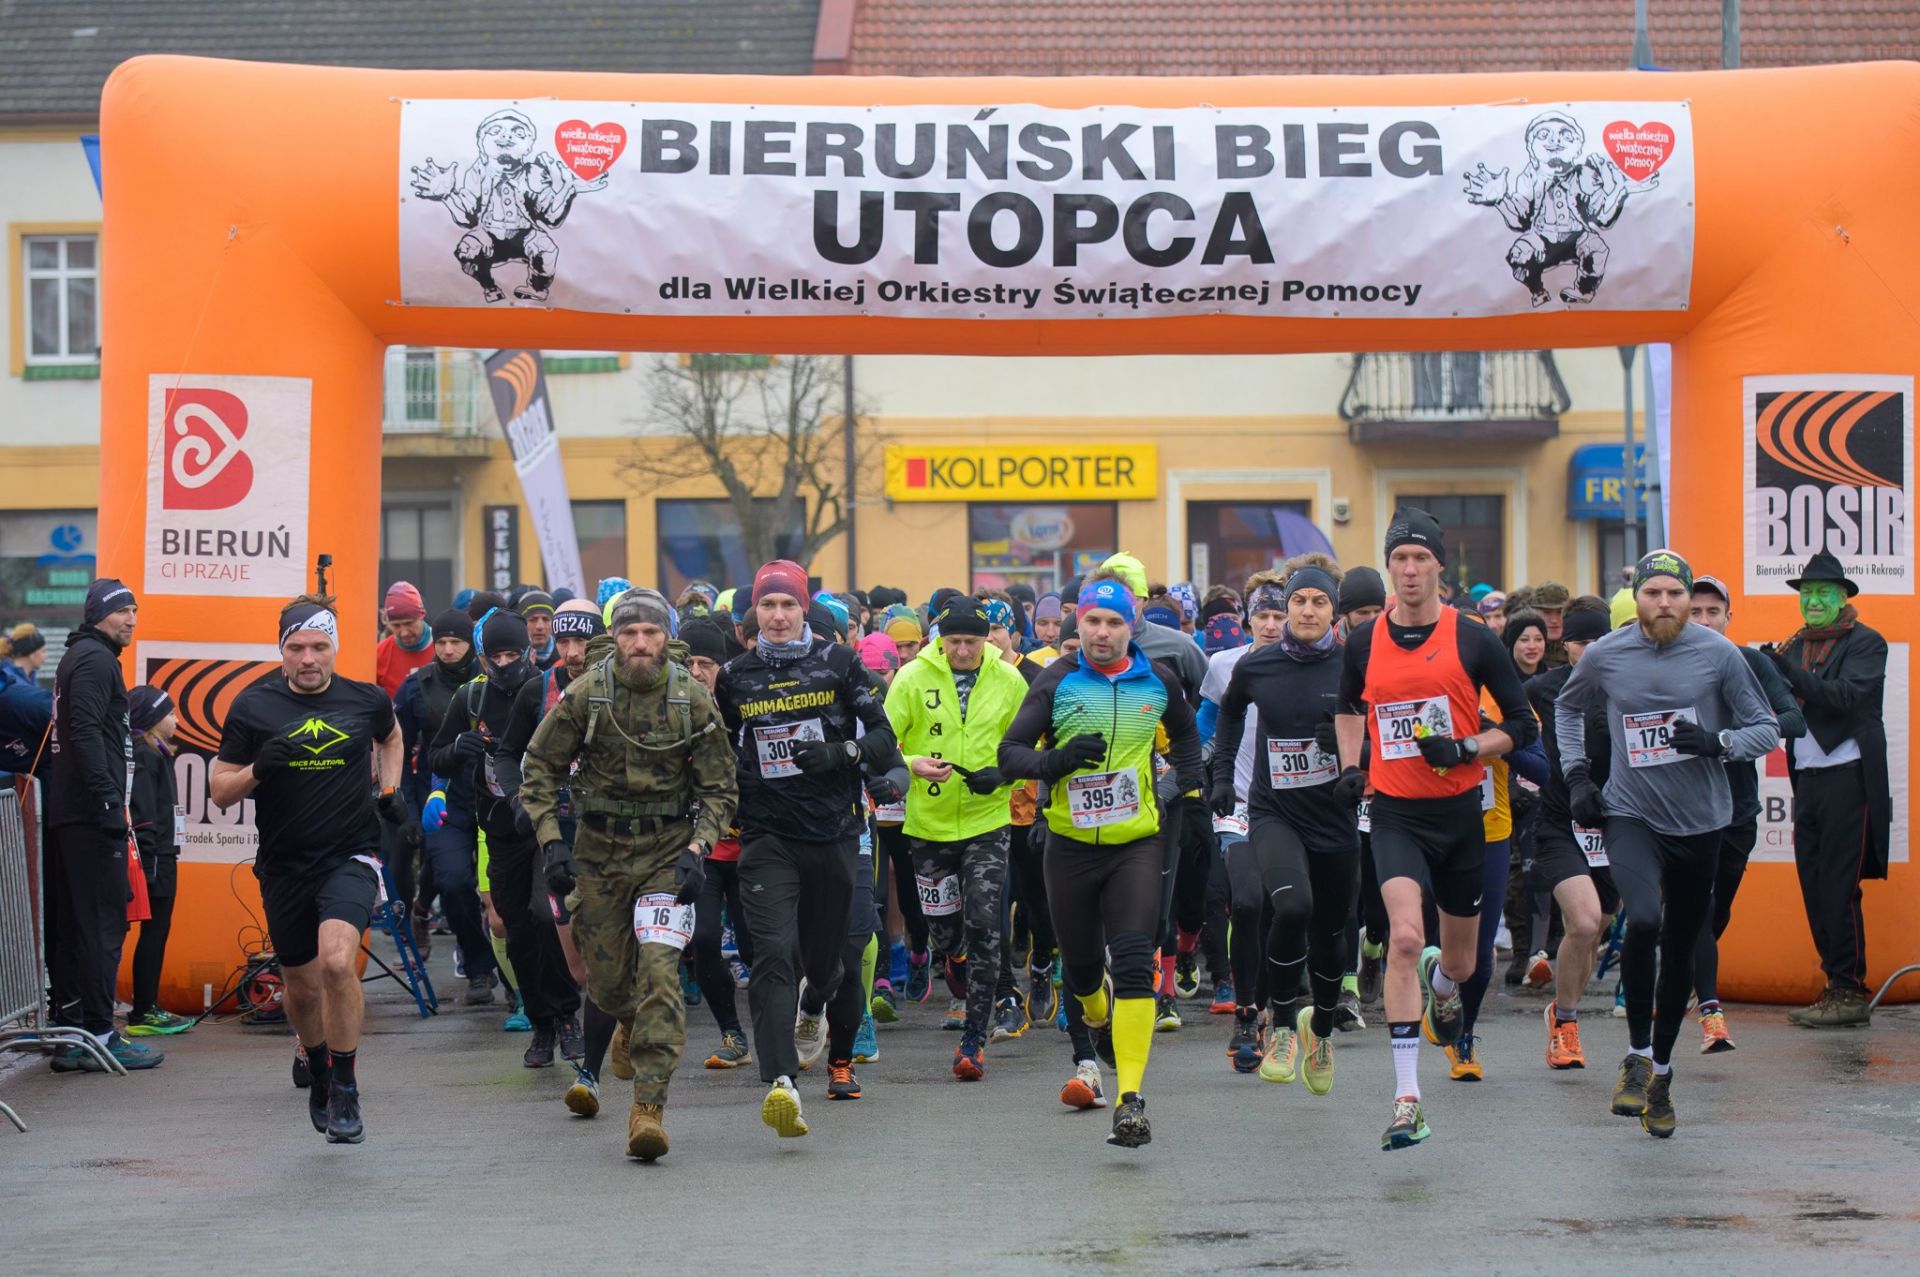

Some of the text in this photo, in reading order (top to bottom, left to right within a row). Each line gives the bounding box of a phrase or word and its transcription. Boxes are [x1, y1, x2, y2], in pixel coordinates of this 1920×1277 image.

[640, 108, 1444, 182] BIERUŃSKI BIEG
[574, 155, 606, 172] pomocy
[1625, 155, 1657, 173] pomocy
[813, 190, 1276, 269] UTOPCA
[659, 276, 1422, 310] dla Wielkiej Orkiestry Świątecznej Pomocy
[930, 456, 1136, 489] KOLPORTER
[1756, 484, 1905, 556] BOSIR
[162, 524, 291, 559] BIERUŃ
[161, 563, 251, 583] CI PRZAJE
[1756, 564, 1795, 577] Bieruński
[1872, 565, 1905, 579] Rekreacji
[739, 689, 836, 718] RUNMAGEDDON
[1639, 726, 1670, 749] 179
[1282, 753, 1309, 772] 310
[1082, 787, 1114, 810] 395
[185, 832, 213, 845] środek
[216, 833, 245, 846] Sportu
[1584, 835, 1603, 852] 31
[1766, 830, 1782, 846] CI
[653, 907, 670, 926] 16
